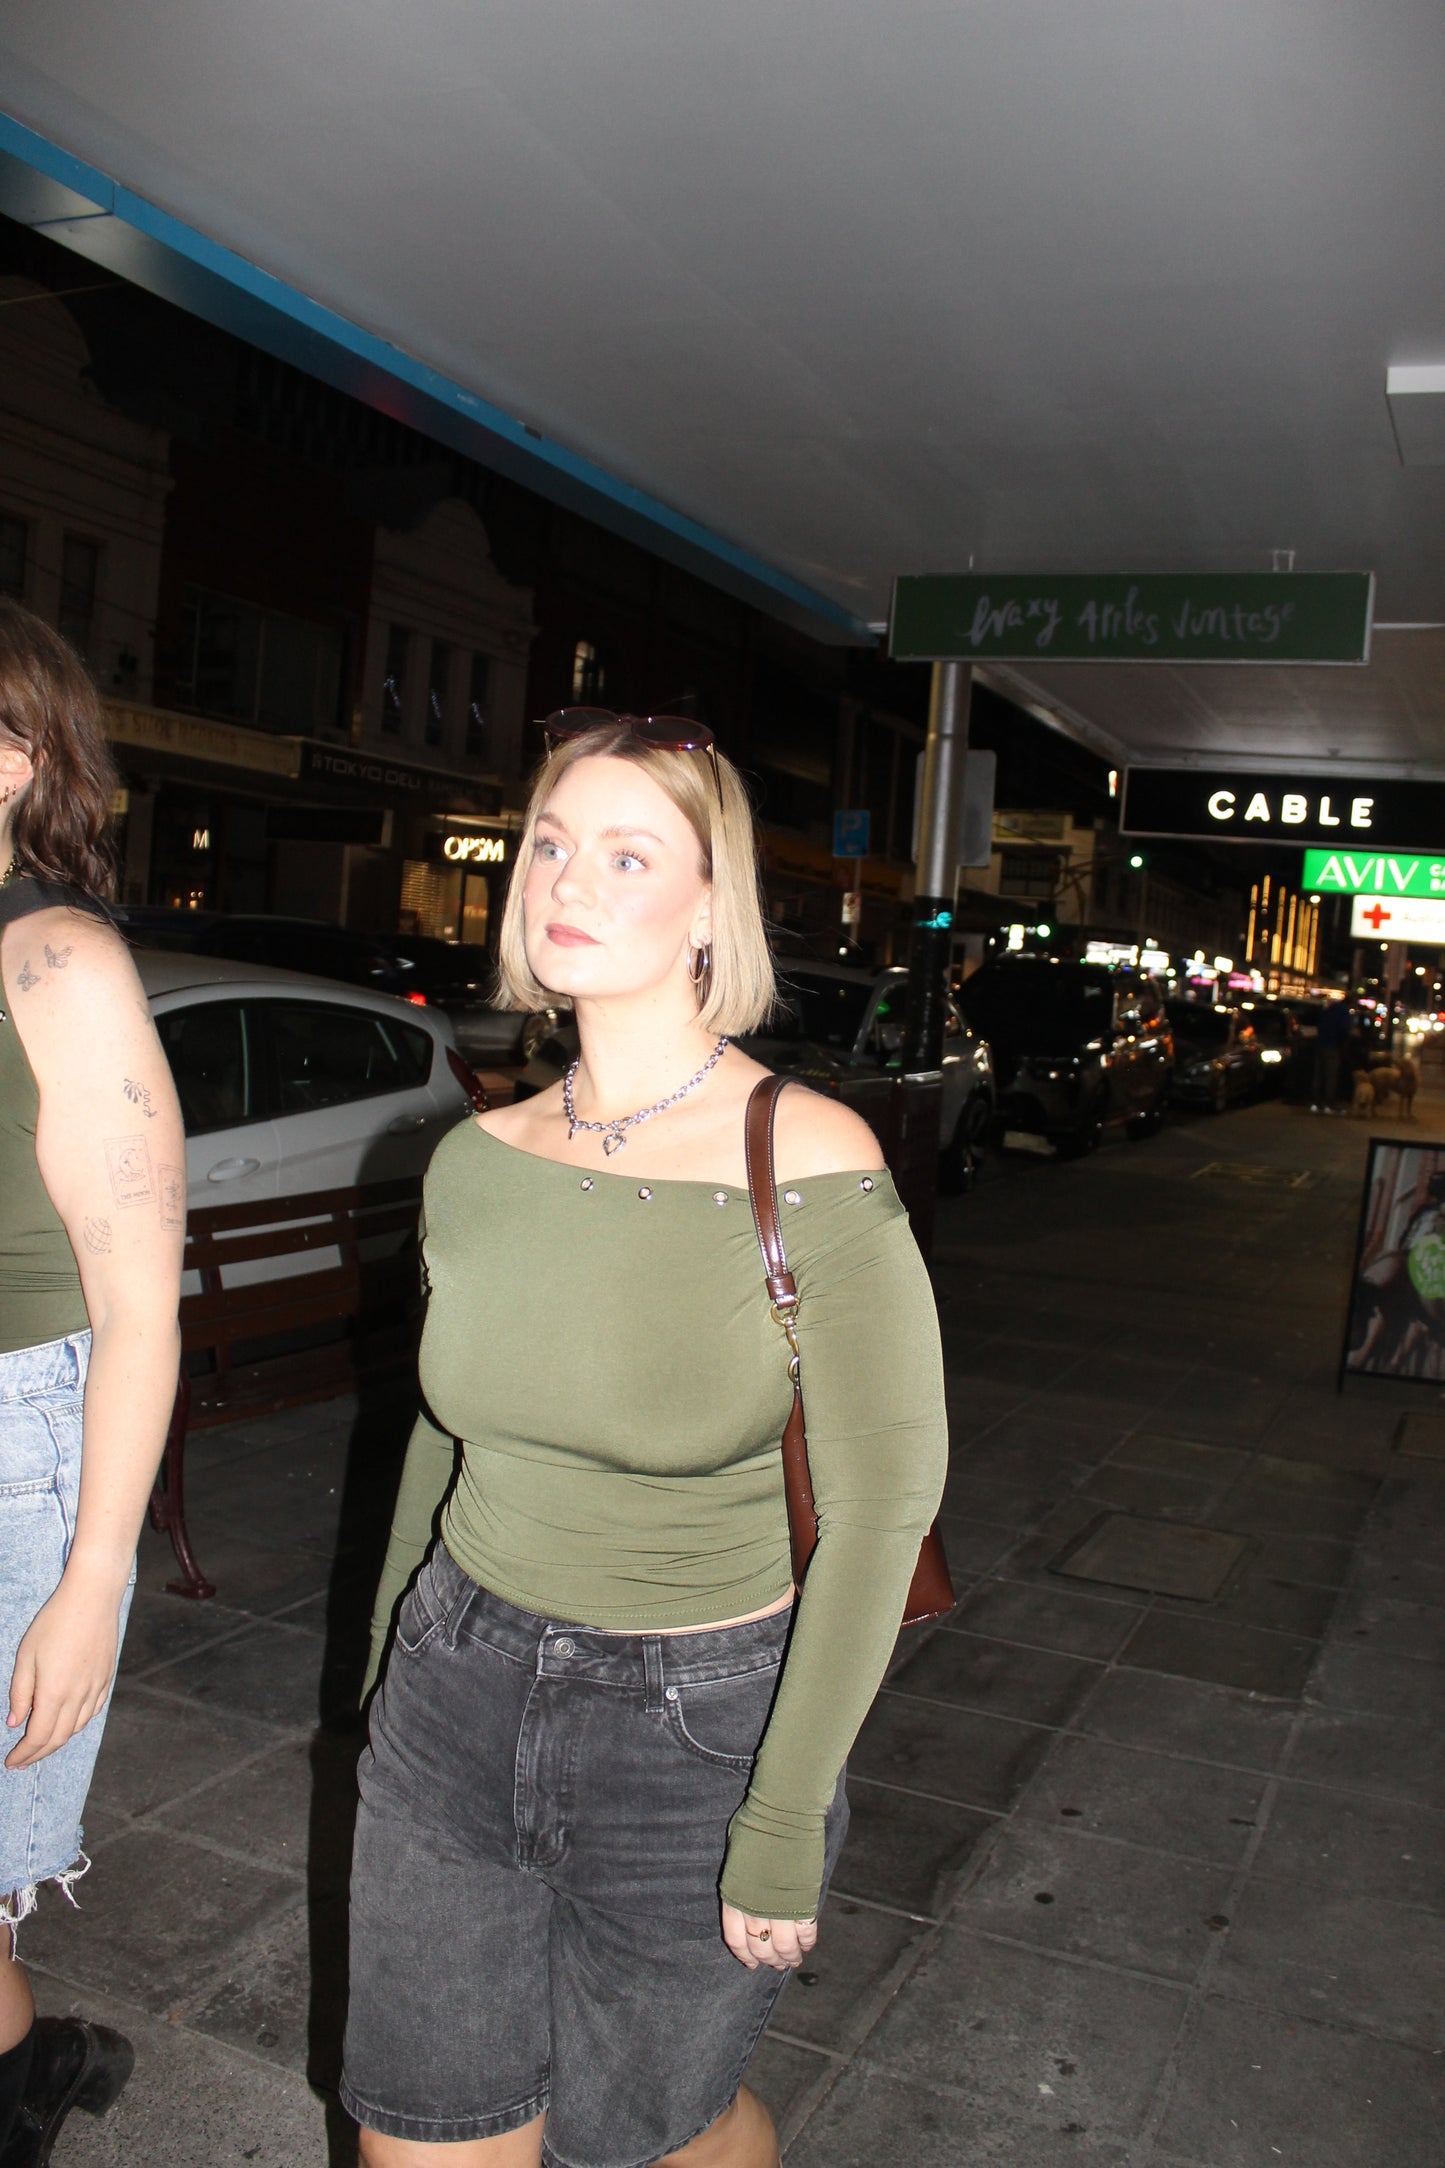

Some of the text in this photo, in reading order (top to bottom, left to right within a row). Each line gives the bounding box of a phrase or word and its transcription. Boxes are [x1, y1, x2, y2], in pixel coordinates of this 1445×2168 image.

[323, 755, 383, 782] TOKYO
[384, 768, 422, 791] DELI
[1207, 790, 1375, 828] CABLE
[443, 836, 506, 862] OPSM
[1315, 855, 1420, 891] AVIV
